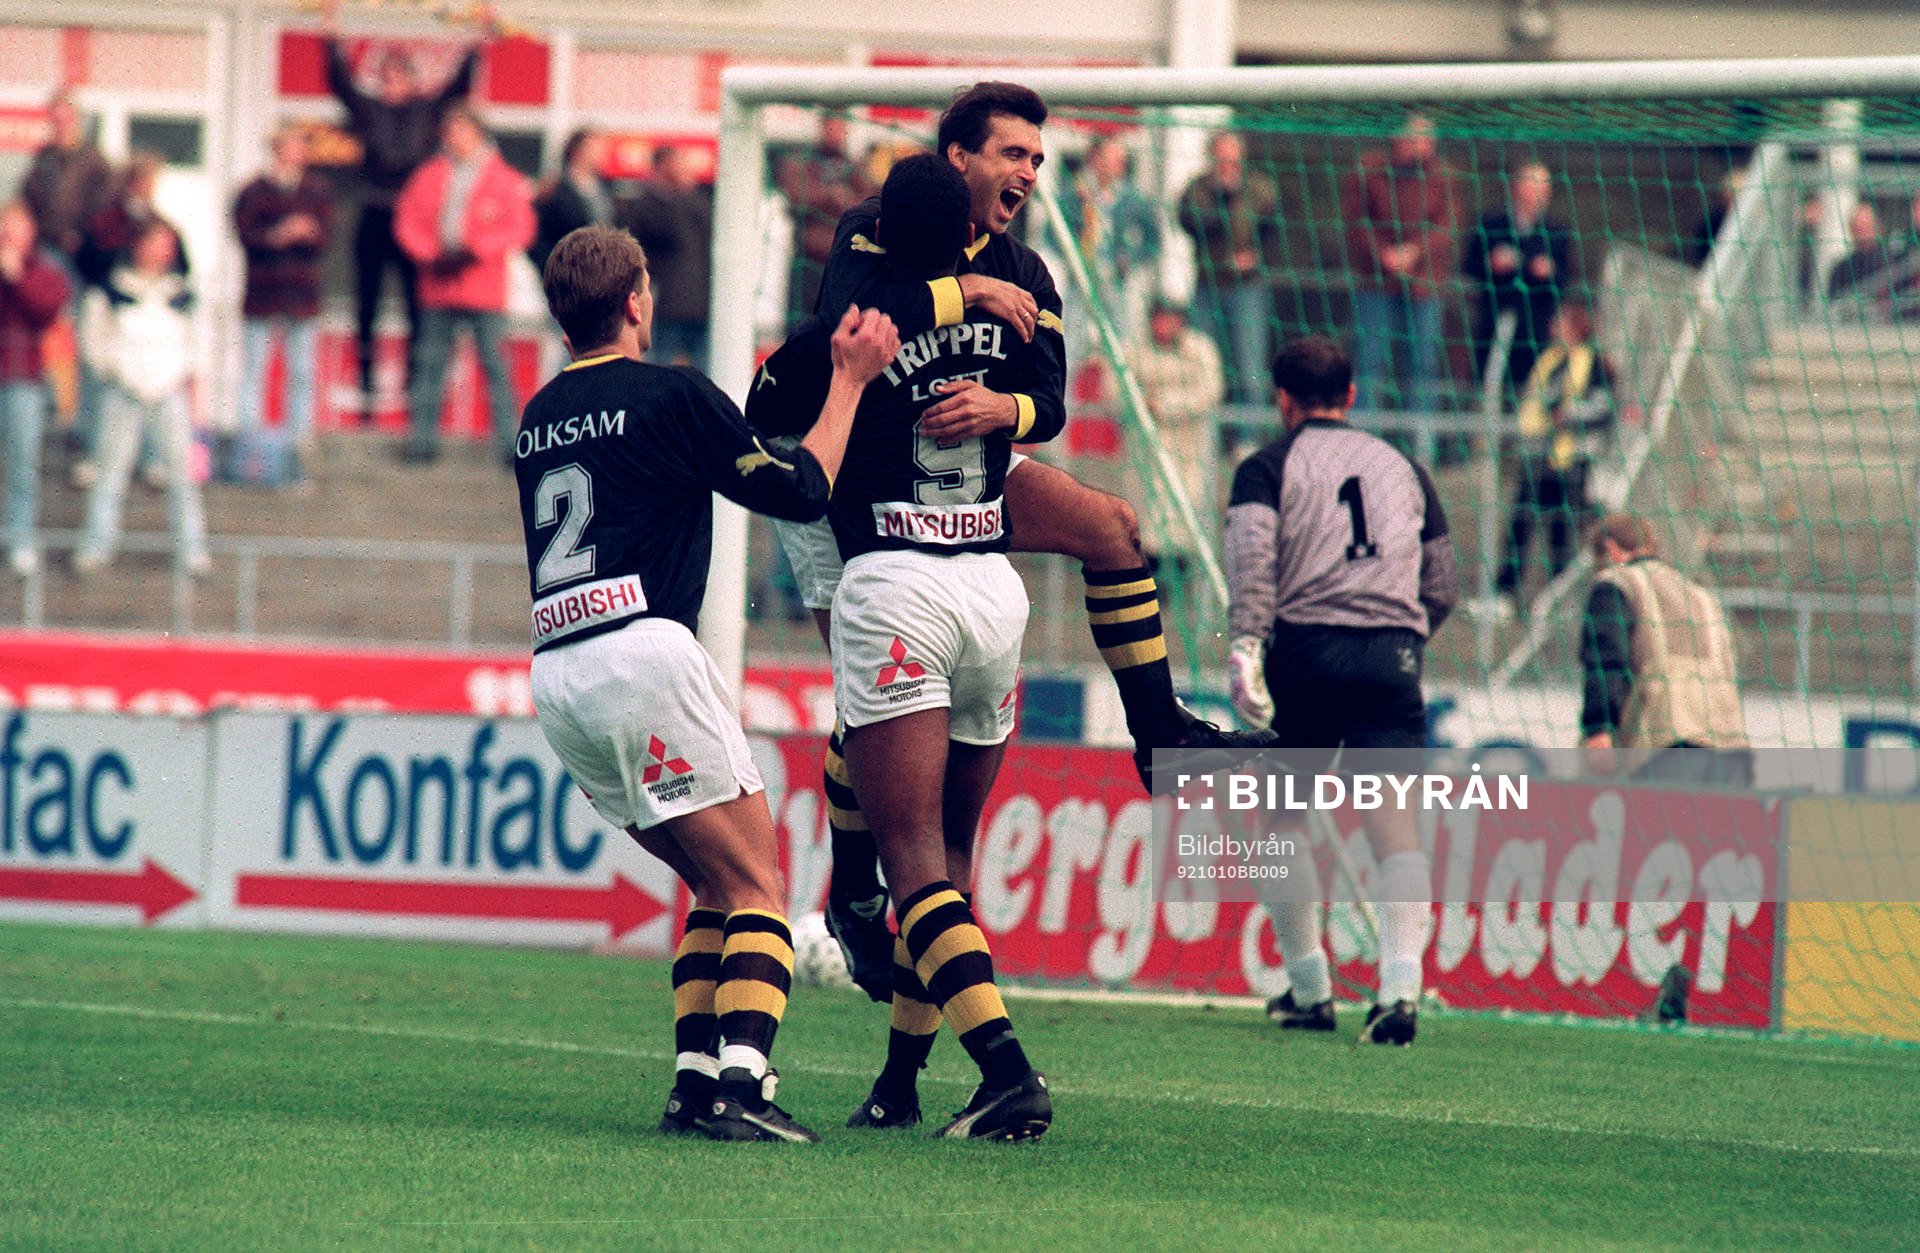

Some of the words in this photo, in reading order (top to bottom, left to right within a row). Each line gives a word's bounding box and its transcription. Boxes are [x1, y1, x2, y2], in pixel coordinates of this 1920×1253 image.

[516, 409, 626, 459] OLKSAM
[913, 416, 987, 504] 9
[534, 462, 597, 593] 2
[1337, 475, 1378, 561] 1
[880, 677, 927, 696] MITSUBISHI
[888, 687, 923, 704] MOTORS
[281, 716, 604, 873] Konfac
[647, 774, 695, 796] MITSUBISHI
[657, 786, 691, 804] MOTORS
